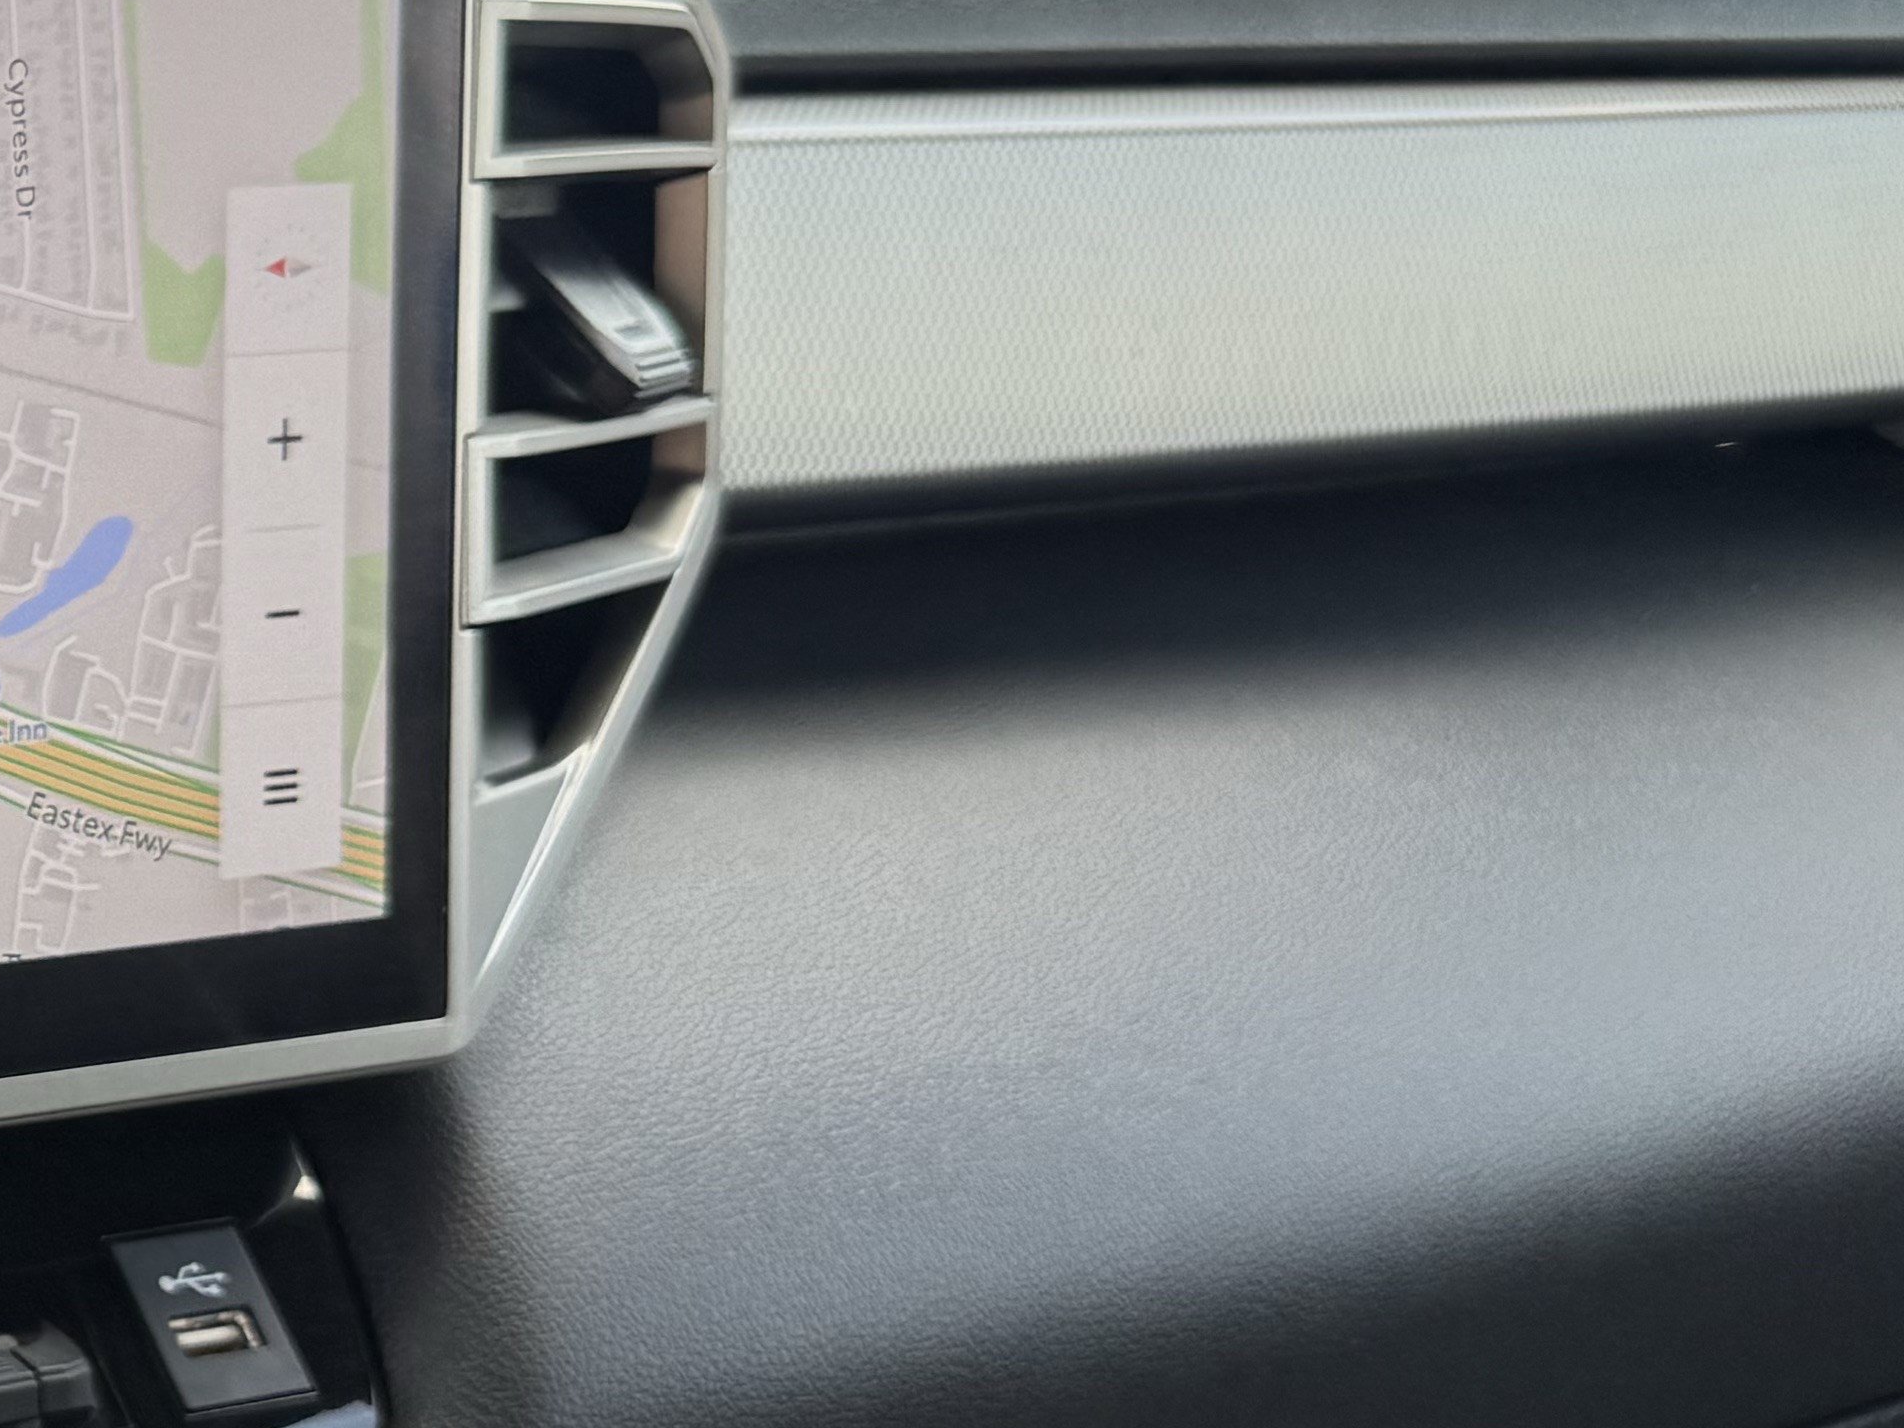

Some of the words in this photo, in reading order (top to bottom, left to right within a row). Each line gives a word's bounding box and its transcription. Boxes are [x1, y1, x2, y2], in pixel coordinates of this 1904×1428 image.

[7, 59, 37, 177] Cypress
[16, 185, 35, 221] Dr
[7, 719, 48, 745] Inn
[26, 792, 116, 845] Eastex
[120, 825, 173, 860] Fwy
